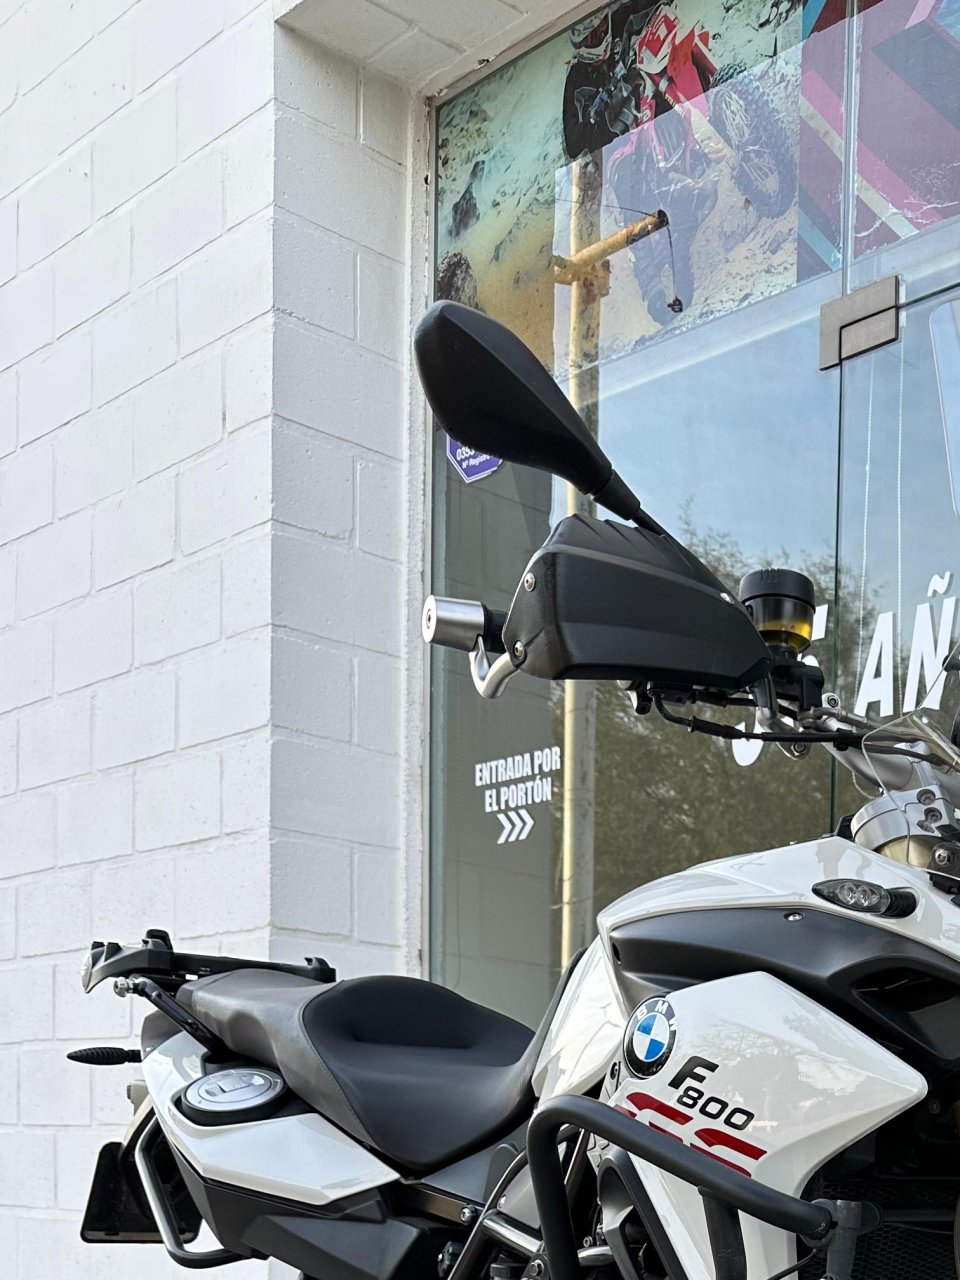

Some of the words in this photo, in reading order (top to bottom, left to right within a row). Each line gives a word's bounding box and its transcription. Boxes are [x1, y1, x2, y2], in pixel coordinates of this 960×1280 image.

[475, 752, 533, 787] ENTRADA
[533, 746, 561, 775] POR
[485, 788, 499, 813] EL
[500, 775, 552, 810] PORTÓN
[636, 999, 678, 1031] BMW
[667, 1055, 720, 1091] F
[676, 1085, 755, 1131] 800
